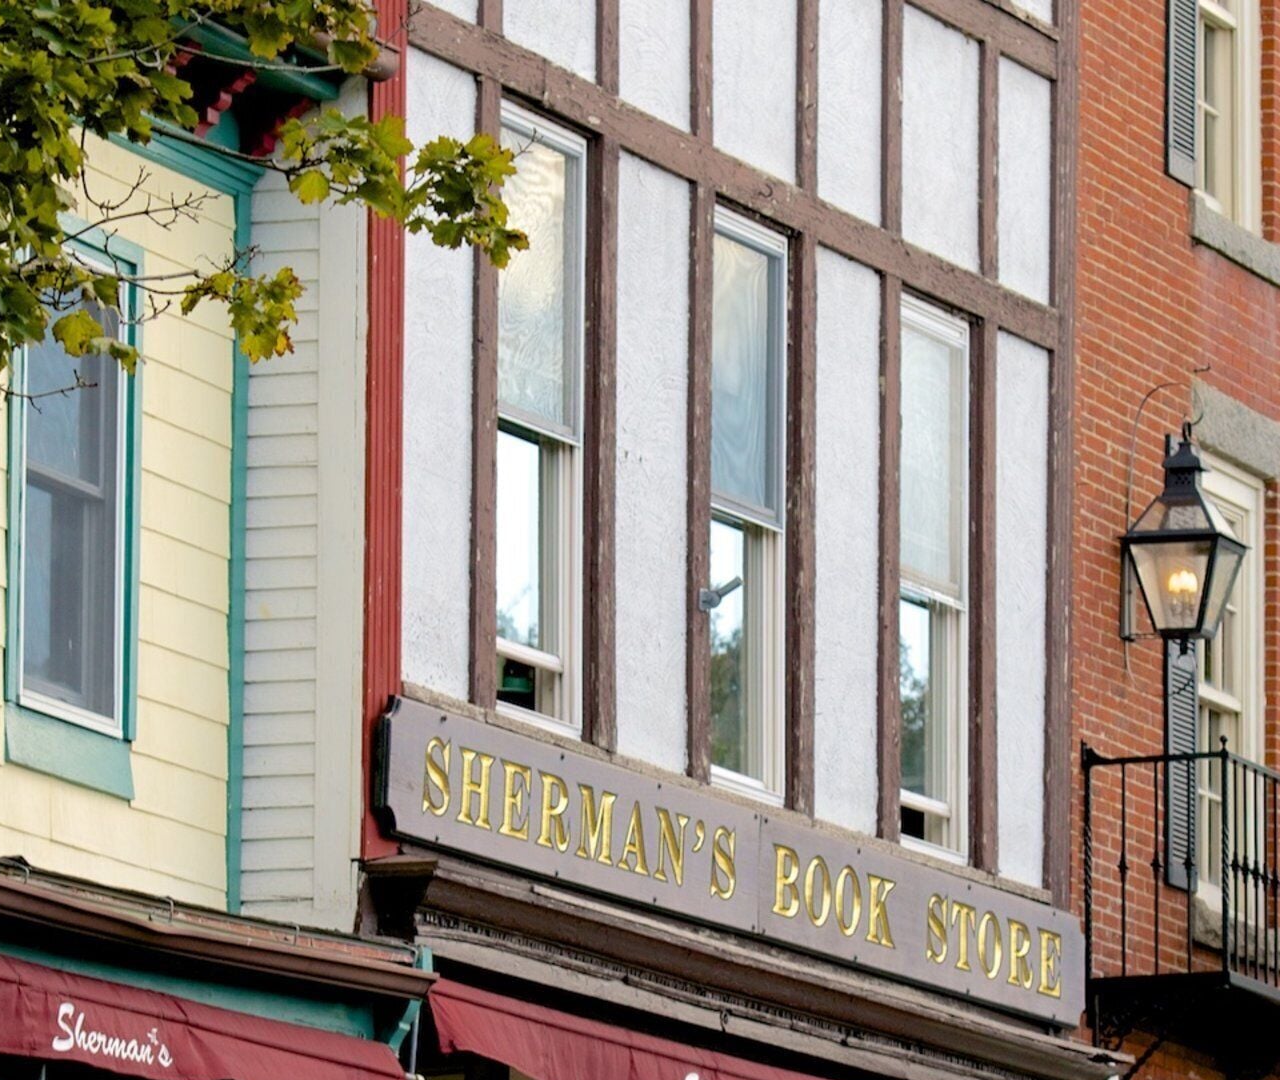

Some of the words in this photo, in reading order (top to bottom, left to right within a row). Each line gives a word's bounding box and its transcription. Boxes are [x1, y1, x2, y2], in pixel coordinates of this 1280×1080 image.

[421, 735, 738, 901] SHERMAN'S
[772, 843, 896, 950] BOOK
[925, 892, 1064, 1000] STORE
[53, 1002, 173, 1068] Sherman's
